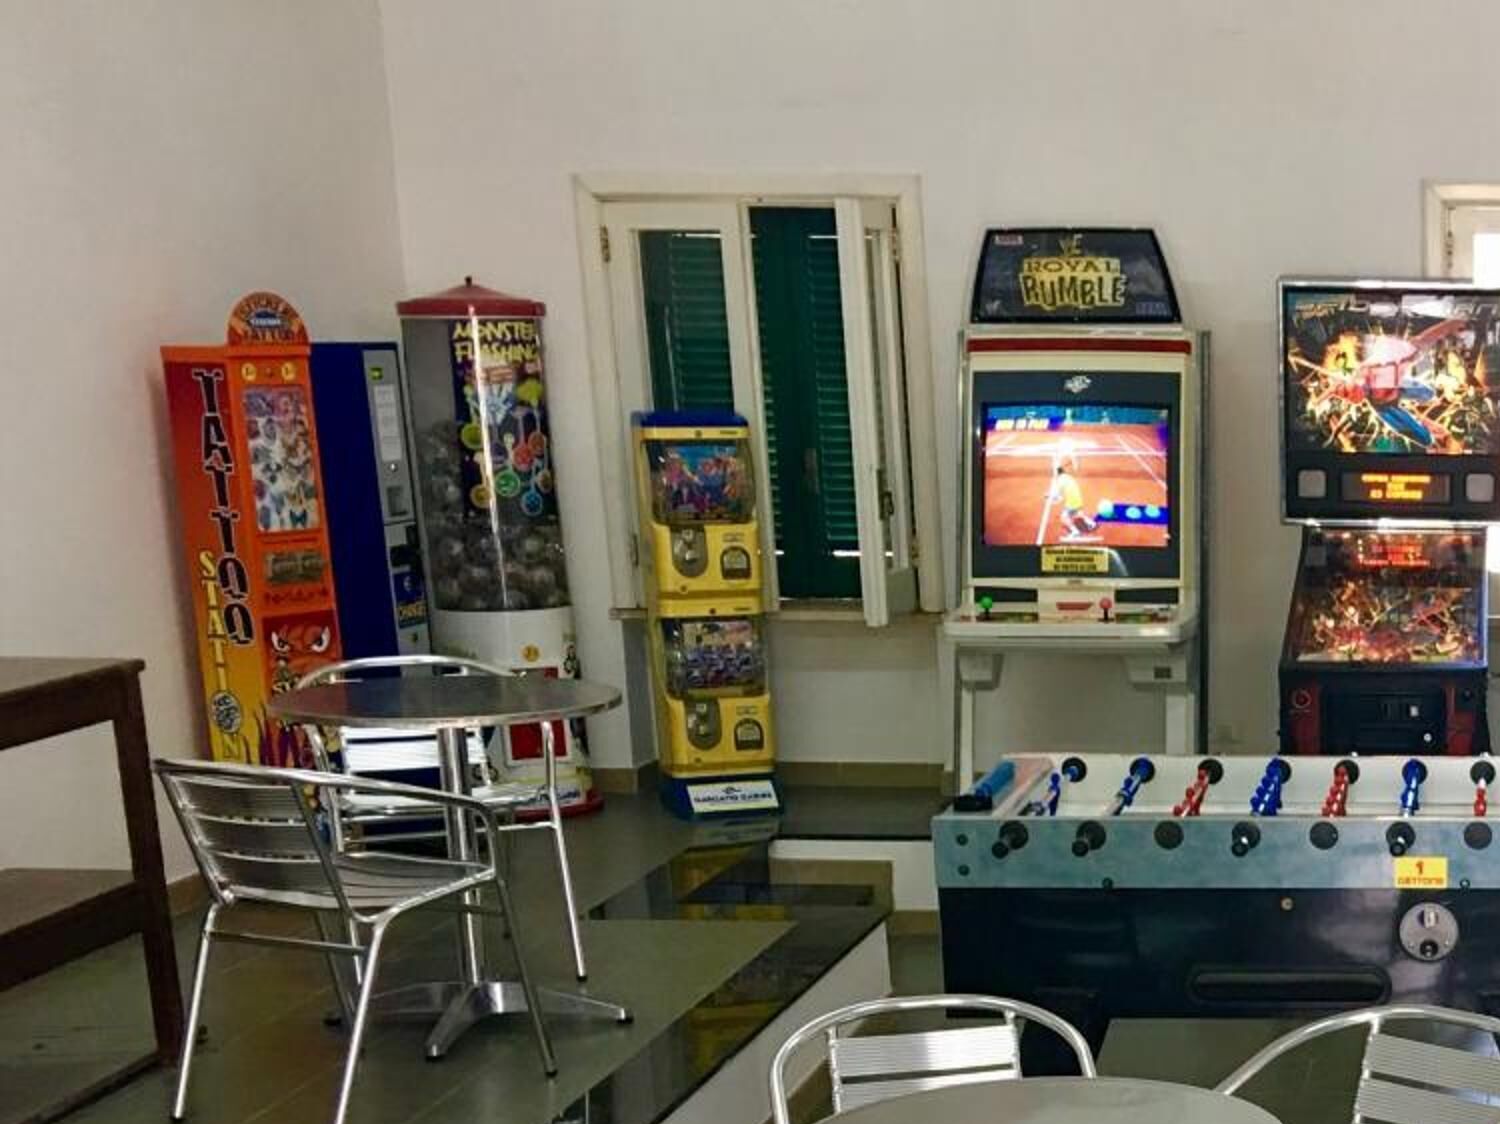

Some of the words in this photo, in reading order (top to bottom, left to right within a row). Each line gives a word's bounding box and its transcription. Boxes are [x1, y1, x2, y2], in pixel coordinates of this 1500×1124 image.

[1026, 260, 1119, 273] ROYAL
[1022, 275, 1127, 307] RUMBLE
[191, 367, 256, 646] TATTOO
[1415, 861, 1425, 875] 1
